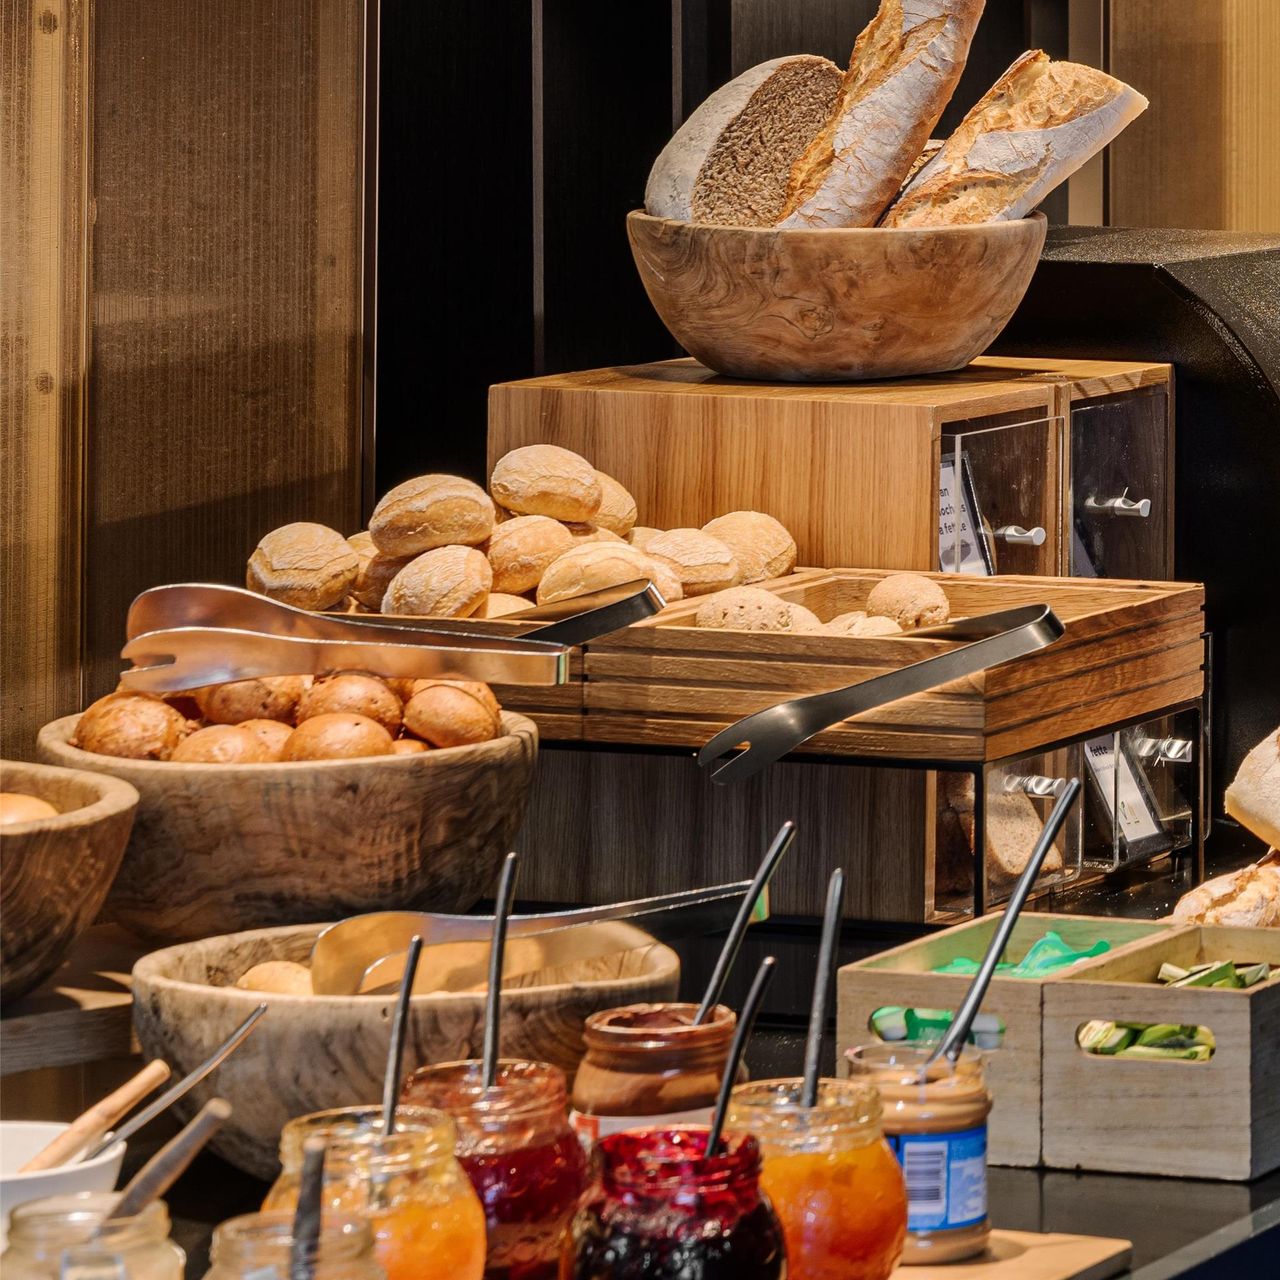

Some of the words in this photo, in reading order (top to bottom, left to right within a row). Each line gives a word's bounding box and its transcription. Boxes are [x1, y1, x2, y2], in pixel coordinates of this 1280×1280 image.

[939, 487, 949, 497] an
[939, 503, 966, 516] ochs
[1090, 745, 1108, 757] fette
